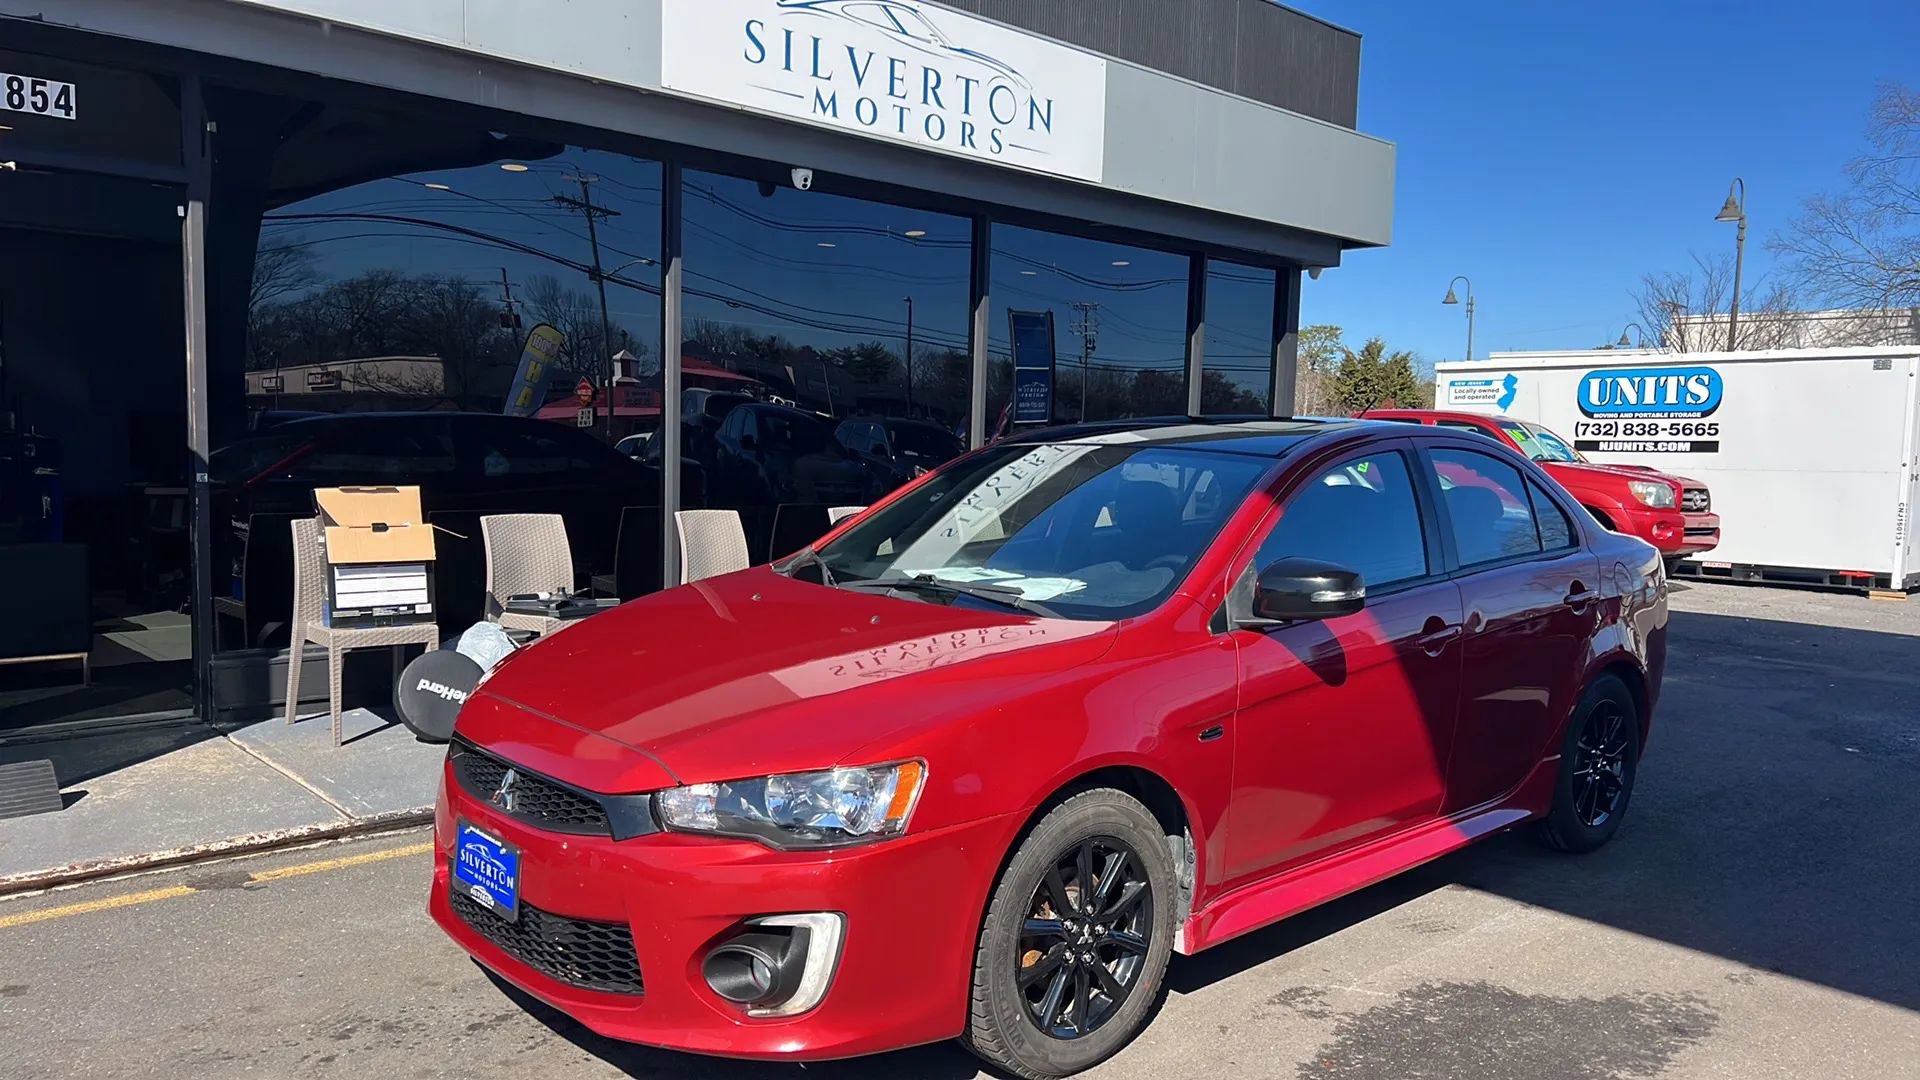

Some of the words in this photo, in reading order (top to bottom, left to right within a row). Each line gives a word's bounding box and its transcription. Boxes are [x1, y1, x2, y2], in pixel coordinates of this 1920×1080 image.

[743, 18, 1053, 134] SILVERTON
[6, 75, 73, 117] 854
[811, 86, 1003, 154] MOTORS
[1588, 374, 1710, 406] UNITS
[1574, 421, 1619, 438] (732)
[1622, 422, 1719, 437] 838-5665
[1598, 441, 1692, 452] NJUNITS.COM
[416, 678, 468, 705] ieHard
[460, 848, 514, 889] SILVERTON
[473, 873, 499, 892] MOTORS
